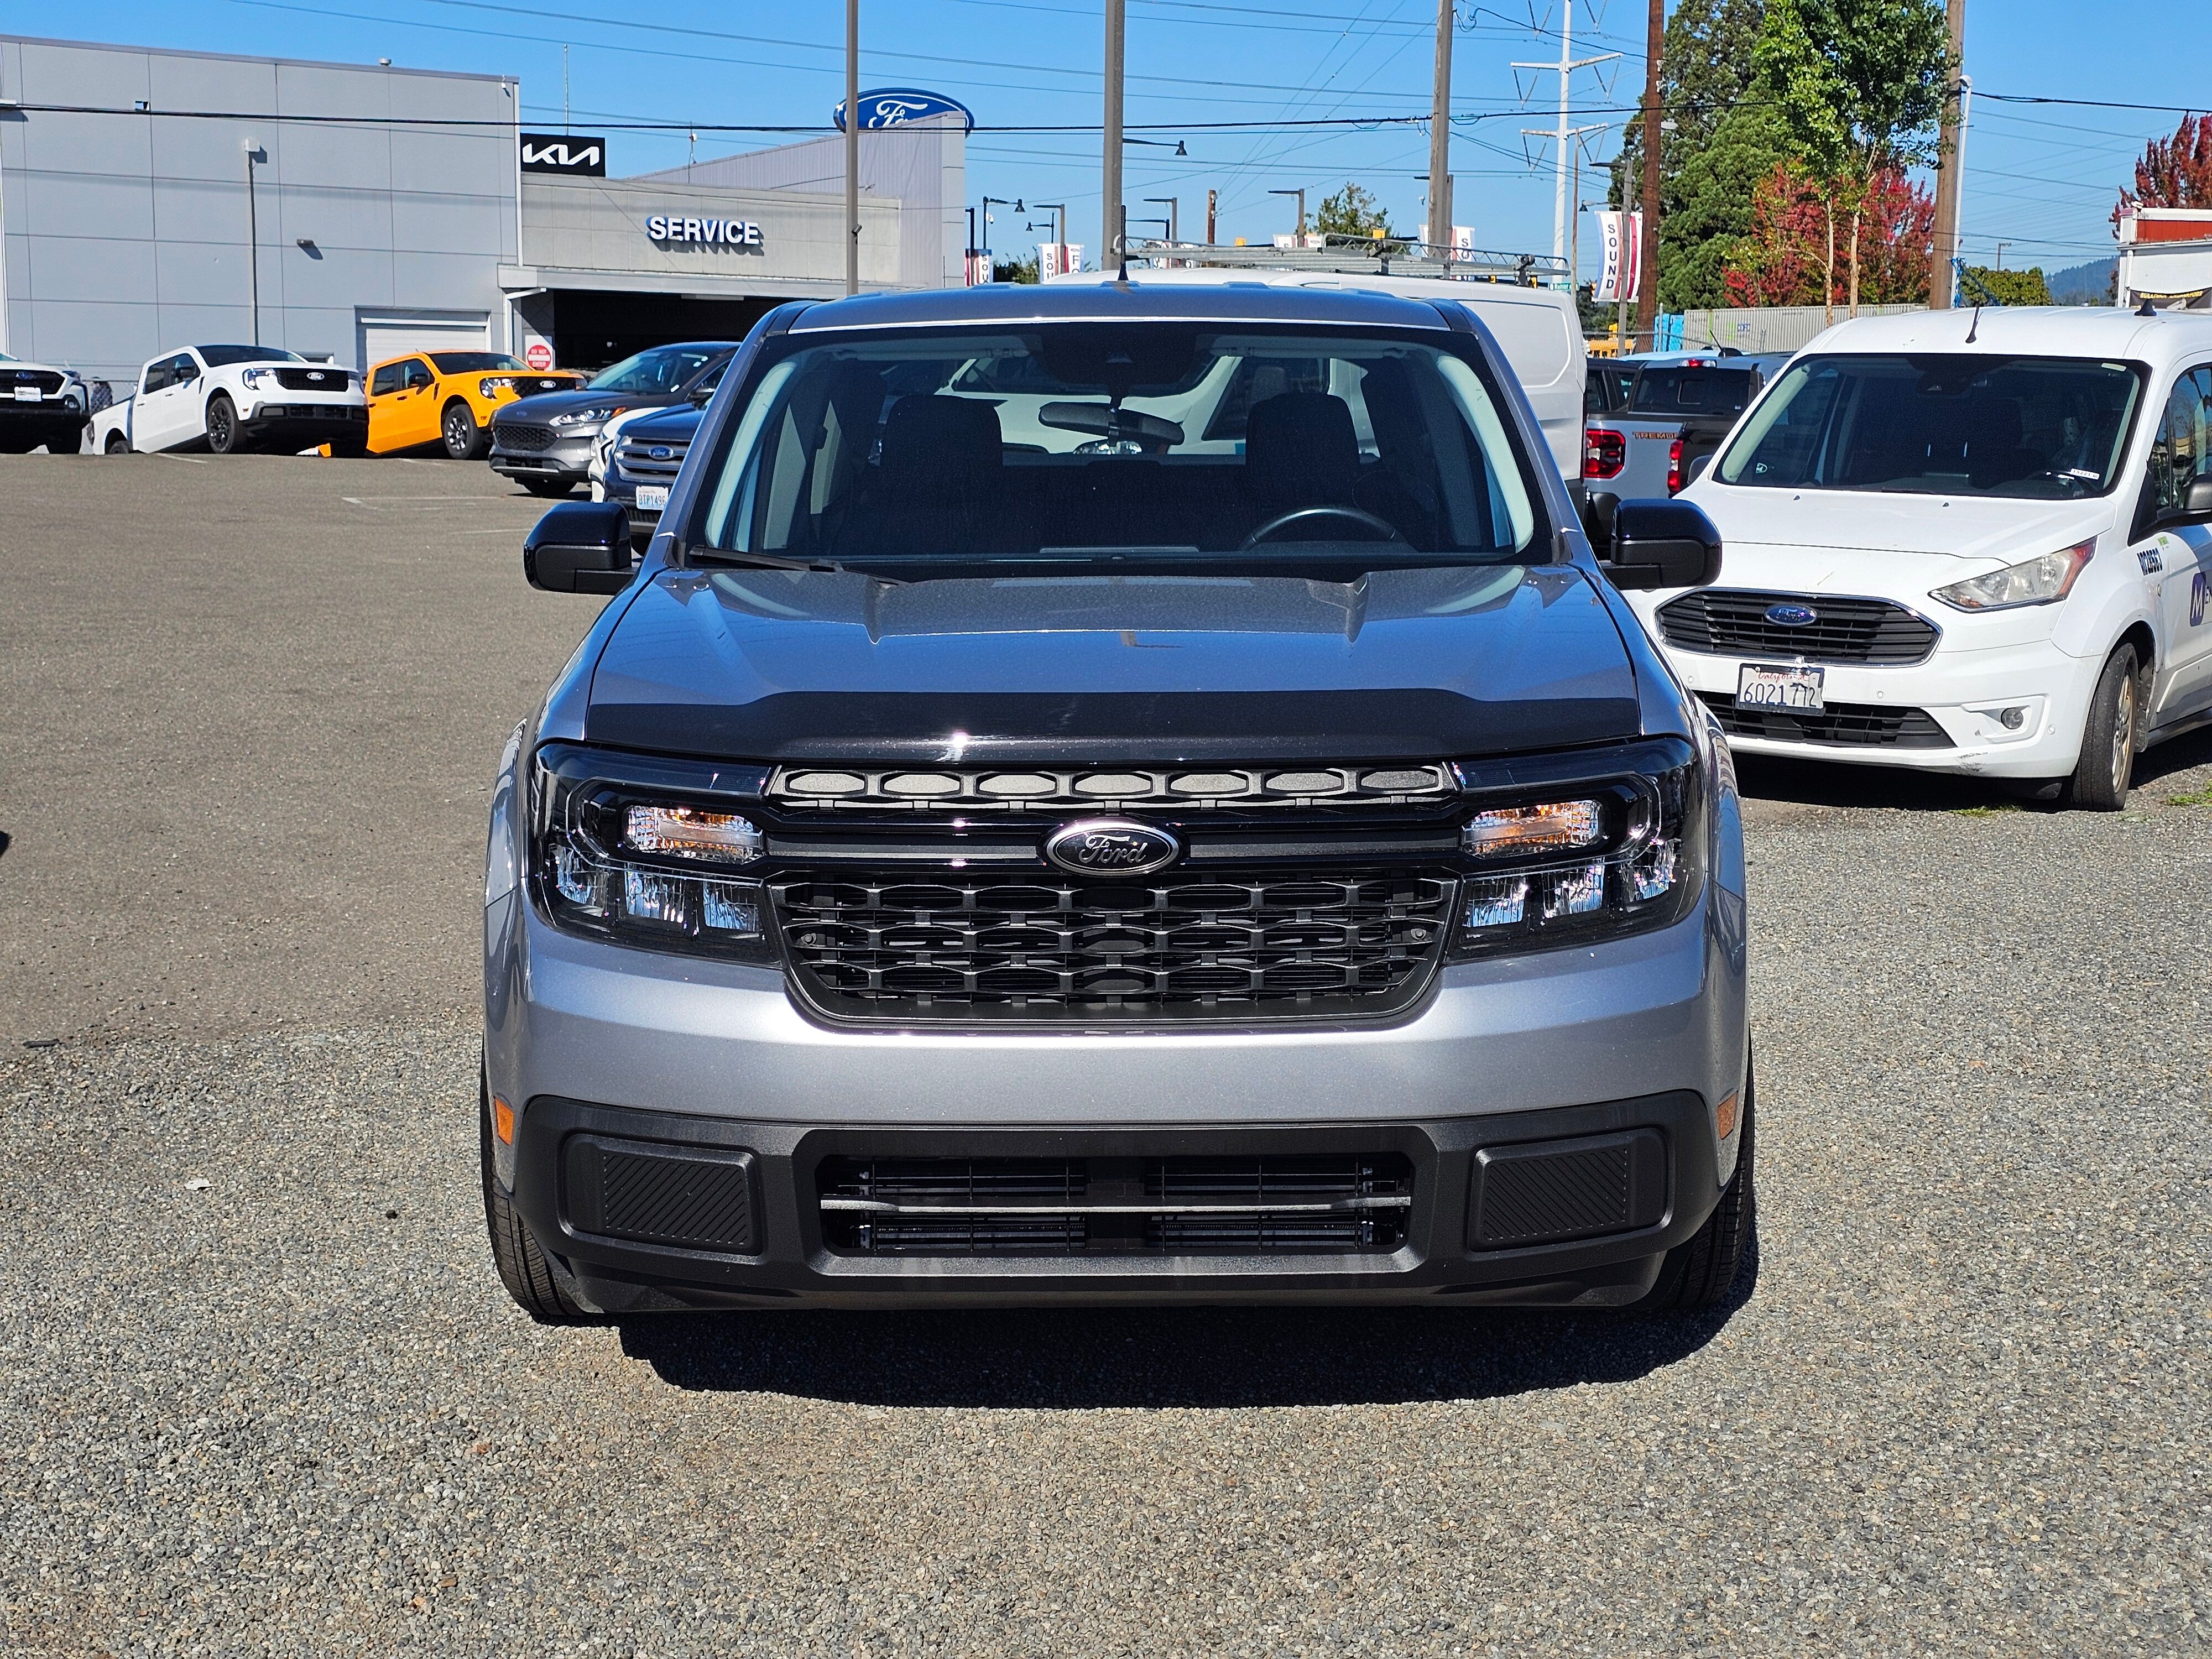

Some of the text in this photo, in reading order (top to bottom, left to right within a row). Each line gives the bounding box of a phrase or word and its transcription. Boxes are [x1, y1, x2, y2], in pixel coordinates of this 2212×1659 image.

[523, 143, 599, 166] KIA
[647, 216, 759, 244] SERVICE
[1606, 224, 1617, 289] SOUND
[1079, 834, 1147, 864] Ford
